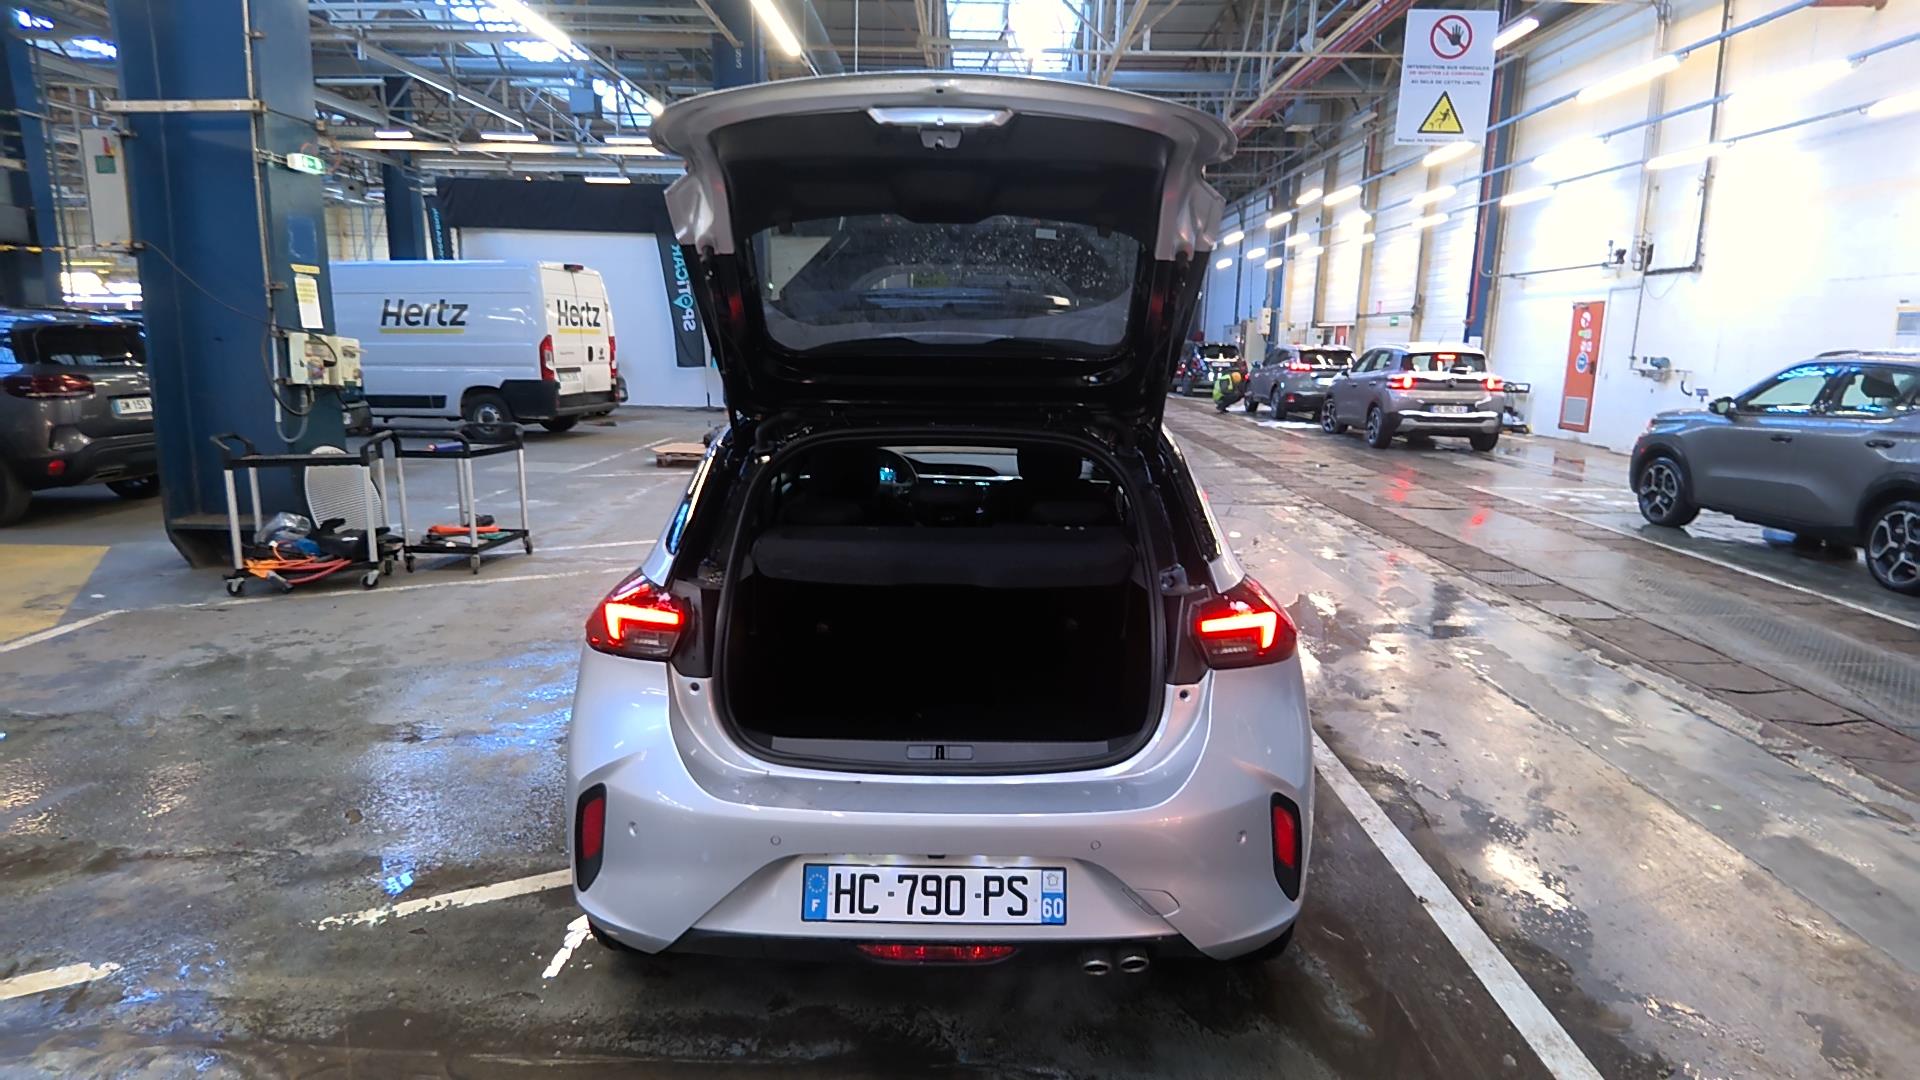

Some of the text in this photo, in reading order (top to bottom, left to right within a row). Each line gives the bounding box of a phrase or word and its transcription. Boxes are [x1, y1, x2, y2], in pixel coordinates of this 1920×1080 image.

[381, 298, 468, 327] Hertz
[557, 299, 601, 327] Hertz
[811, 899, 821, 912] F
[1042, 897, 1064, 918] 60
